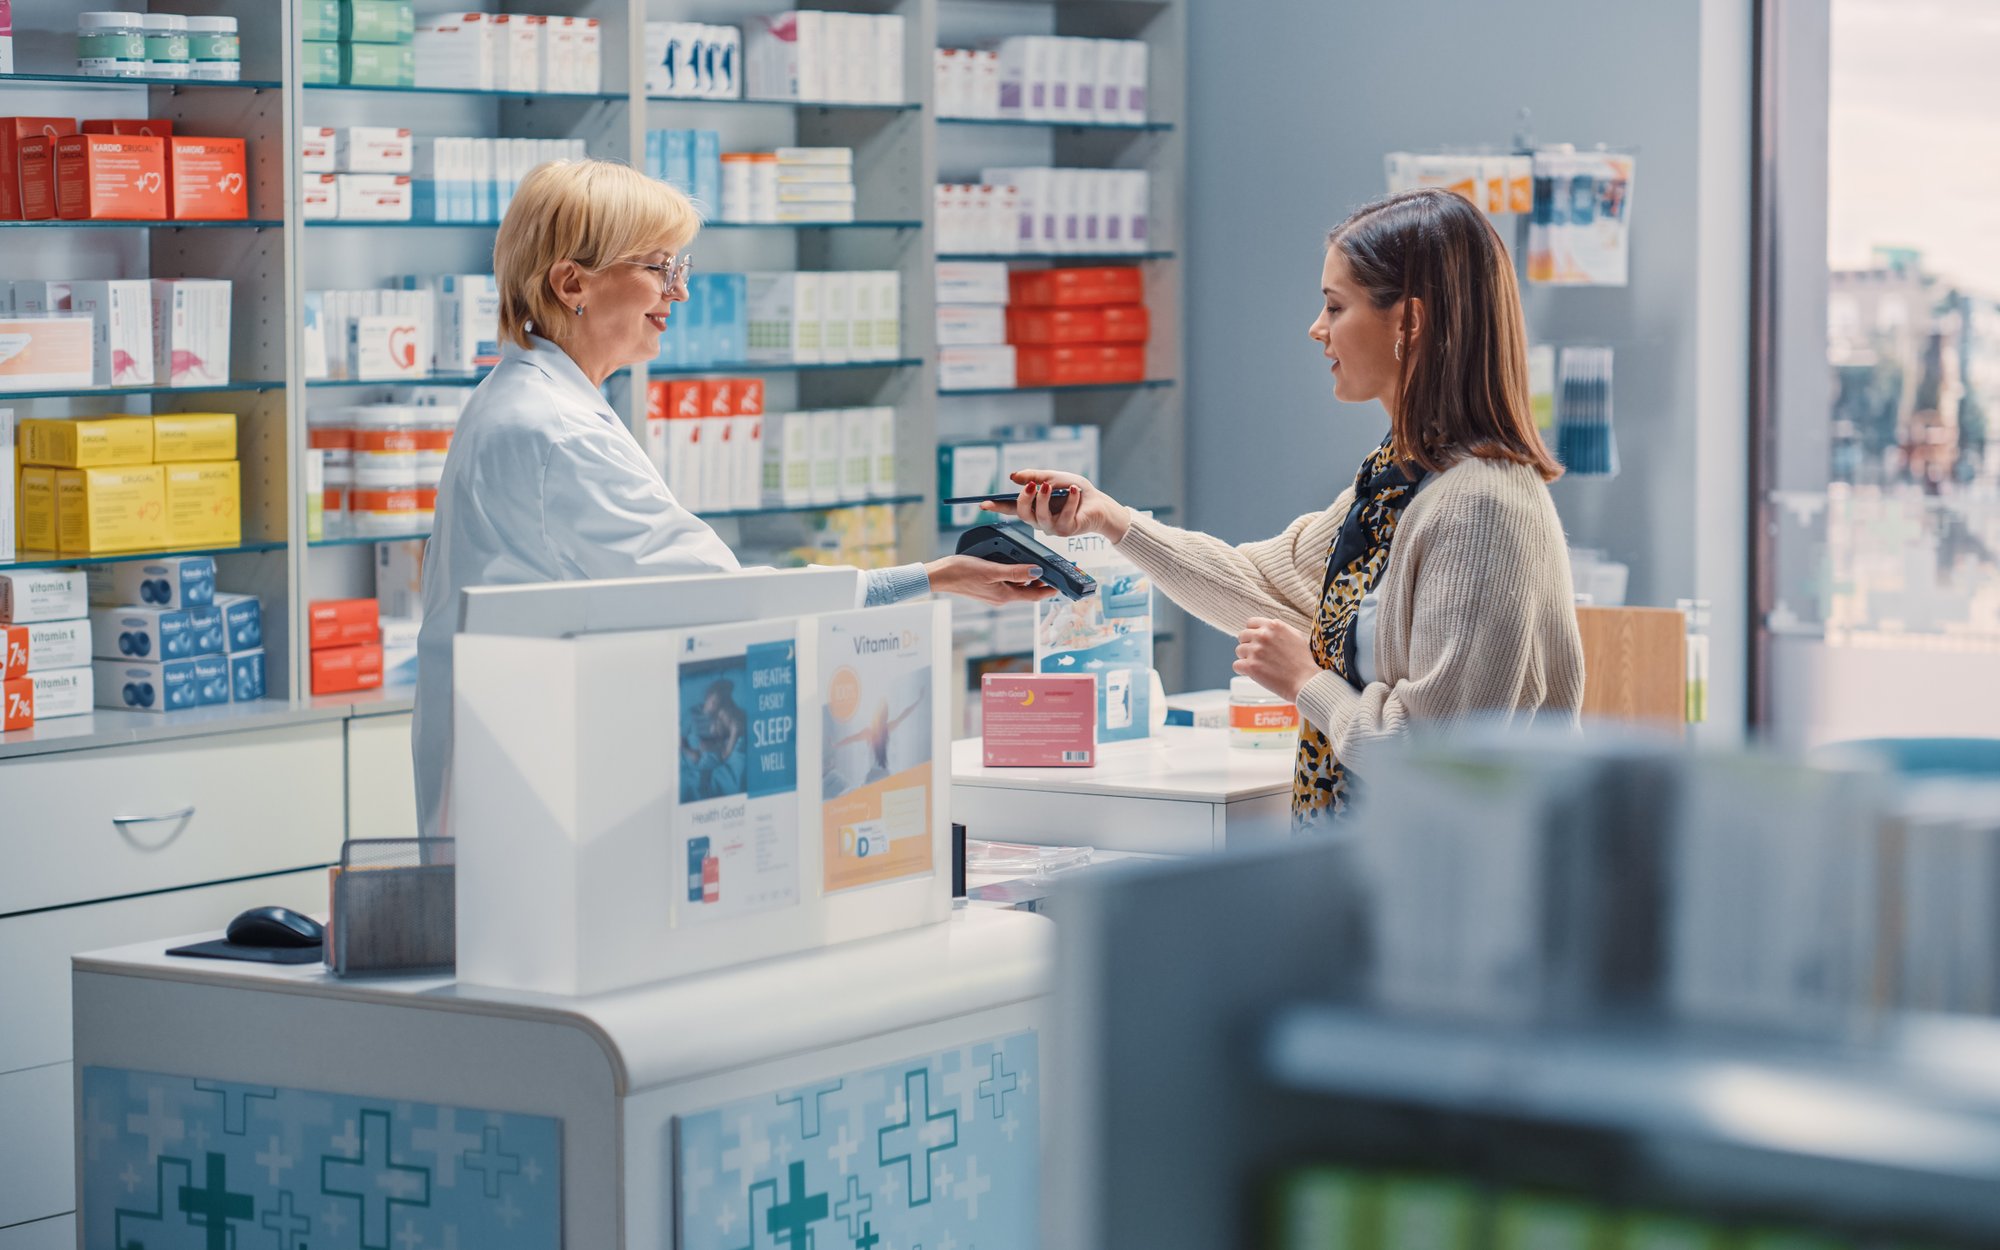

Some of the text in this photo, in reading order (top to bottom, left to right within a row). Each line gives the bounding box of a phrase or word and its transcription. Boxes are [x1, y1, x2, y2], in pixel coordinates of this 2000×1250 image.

[93, 143, 154, 153] KARDIO CRUCIAL
[121, 475, 155, 484] CRUCIAL
[1068, 536, 1105, 552] FATTY
[29, 581, 72, 593] Vitamin E
[32, 629, 75, 643] Vitamin E
[853, 632, 899, 655] Vitamin
[9, 642, 27, 668] 7%
[35, 676, 78, 689] Vitamin E
[752, 666, 792, 689] BREATHE
[759, 692, 785, 711] EASILY
[986, 690, 1026, 698] Health Good
[9, 693, 31, 719] 7%
[1254, 713, 1293, 729] Energy
[753, 716, 792, 748] SLEEP
[760, 752, 785, 772] WELL
[692, 803, 745, 825] Health Good
[856, 837, 869, 858] D
